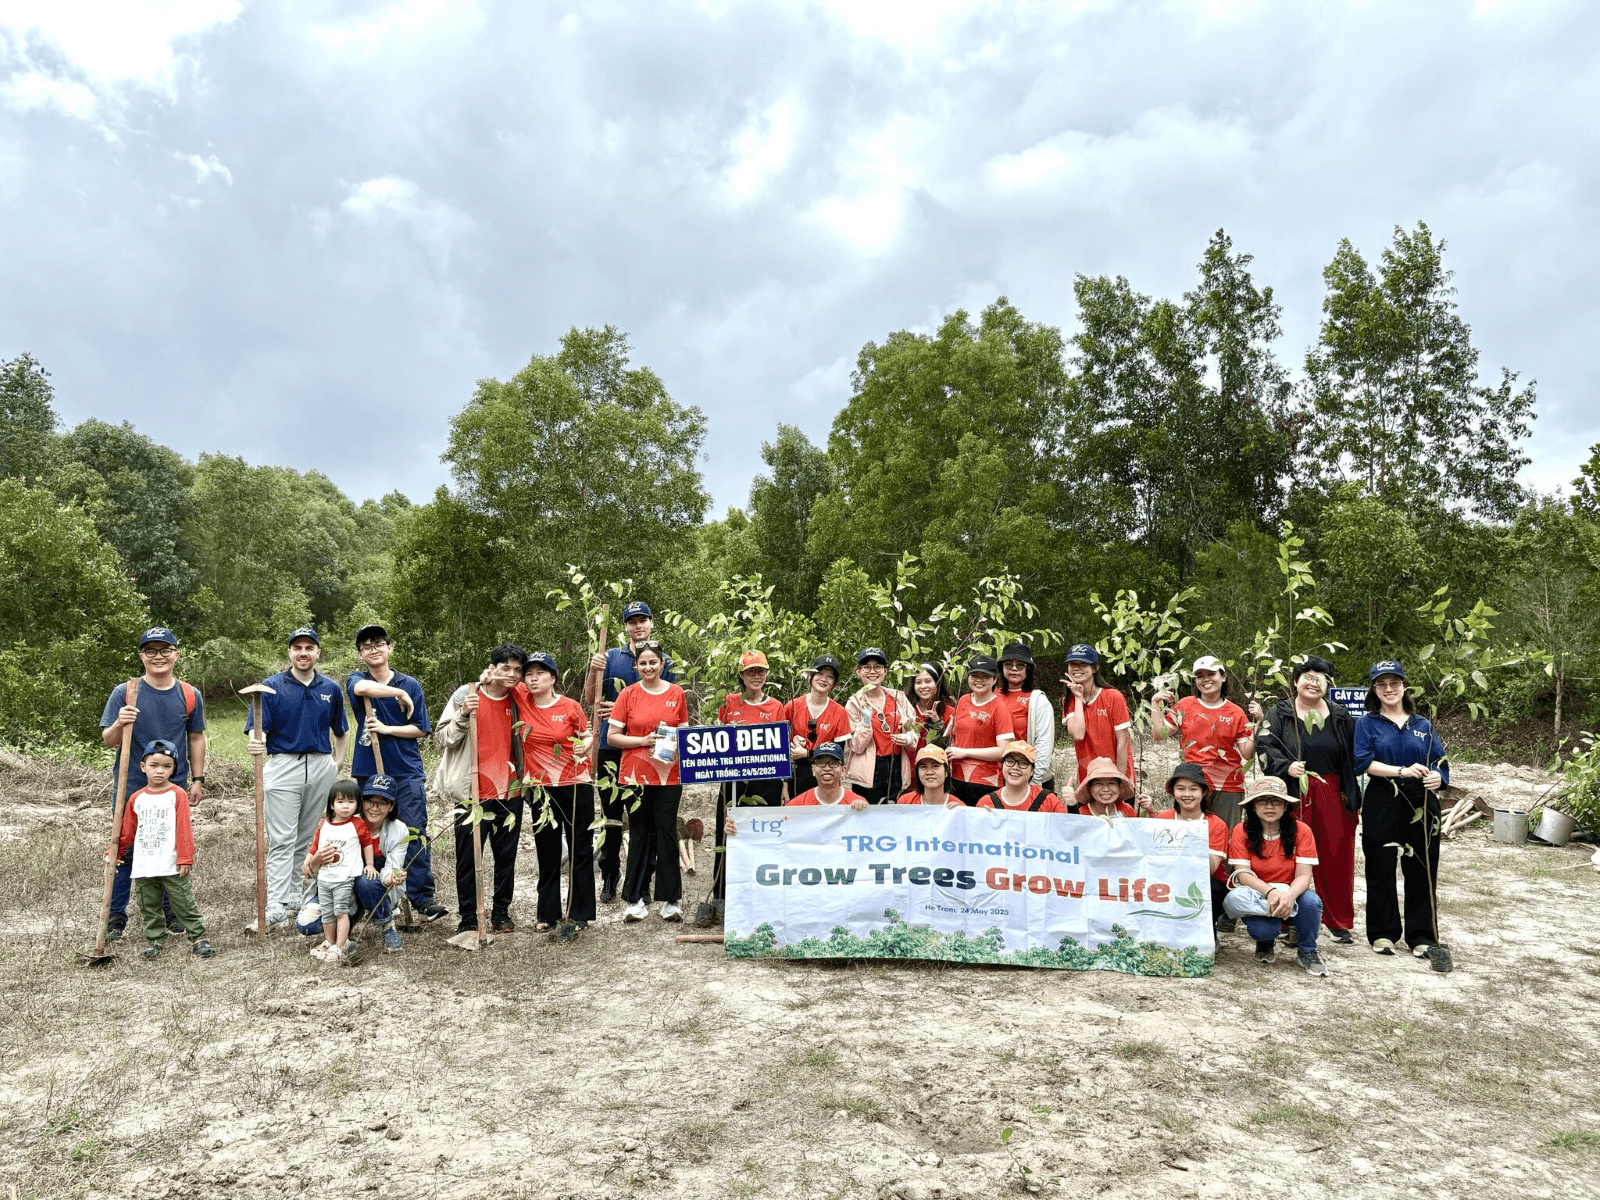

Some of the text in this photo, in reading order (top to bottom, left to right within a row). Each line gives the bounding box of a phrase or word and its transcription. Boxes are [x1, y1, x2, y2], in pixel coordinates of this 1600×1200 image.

[320, 693, 331, 703] trg
[1335, 689, 1351, 701] CÂY
[552, 714, 564, 723] trg
[686, 727, 782, 755] SAO ĐEN
[1413, 729, 1425, 741] trg
[682, 753, 788, 768] TÊN ĐOÀN: TRG INTERNATIONAL
[695, 769, 714, 780] NGÀY
[742, 766, 777, 777] 24/5/2025
[751, 818, 784, 838] trg
[842, 835, 1079, 865] TRG International
[755, 863, 1171, 903] Grow Trees Grow Life
[971, 907, 988, 916] May
[990, 908, 1009, 916] 2025
